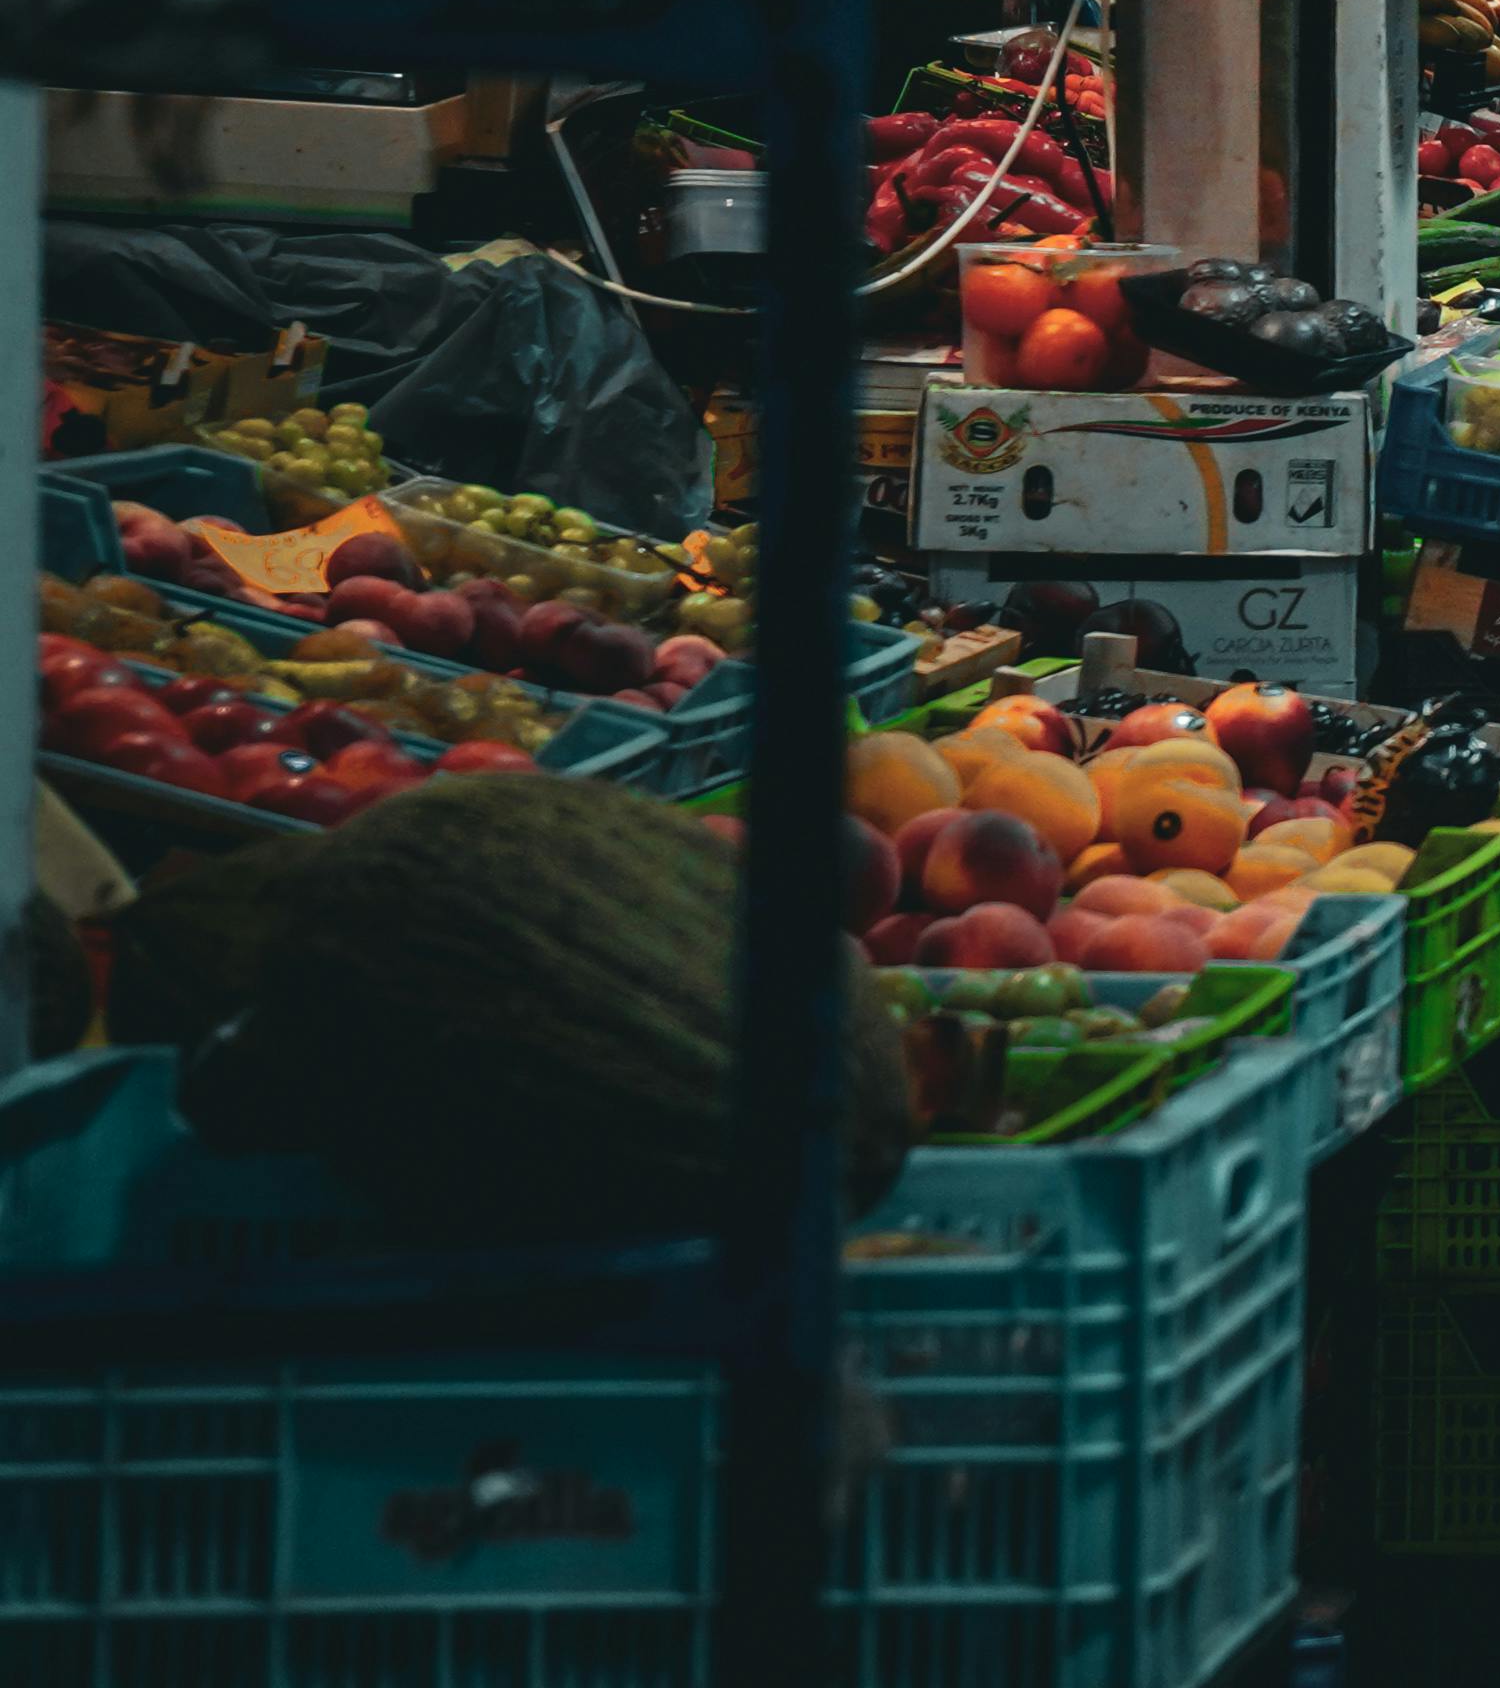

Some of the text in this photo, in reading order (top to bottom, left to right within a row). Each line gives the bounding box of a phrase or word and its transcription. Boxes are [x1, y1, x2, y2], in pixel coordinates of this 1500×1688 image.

[1190, 403, 1351, 417] PRODUCE OF KENYA
[953, 493, 999, 509] 2.7Kg
[1238, 588, 1309, 631] GZ
